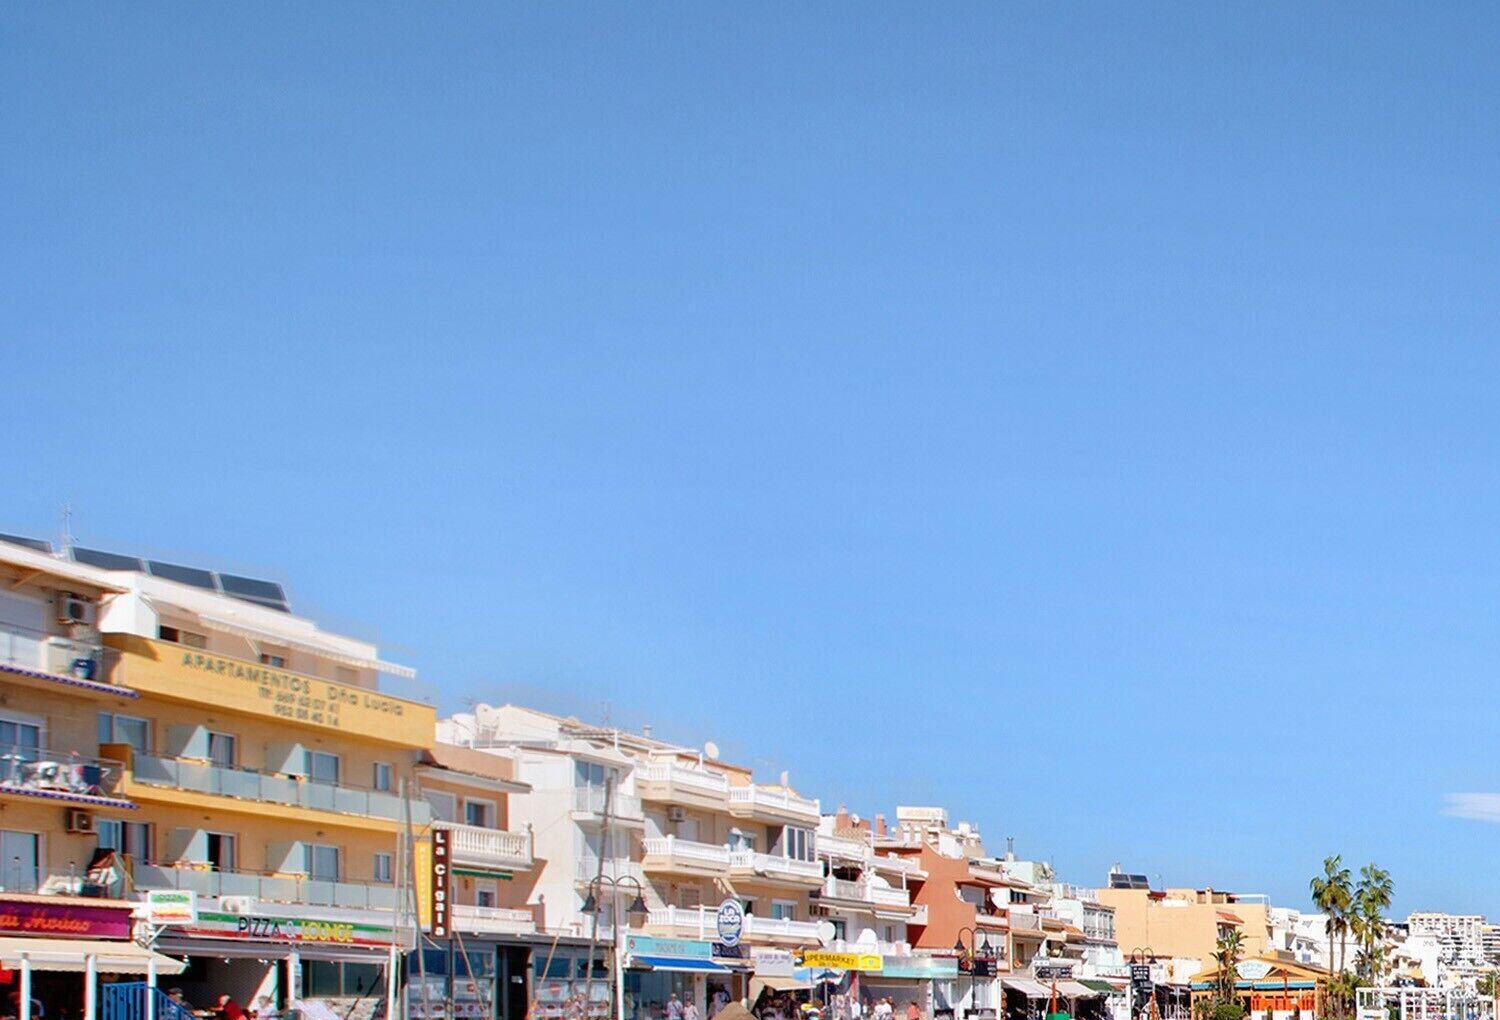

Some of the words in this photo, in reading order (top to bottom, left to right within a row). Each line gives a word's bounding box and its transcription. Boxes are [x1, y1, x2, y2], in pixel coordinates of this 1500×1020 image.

[181, 652, 311, 695] APARTAMENTOS
[434, 831, 447, 856] La
[434, 863, 447, 937] Cigala
[238, 916, 281, 938] PIZZA
[285, 920, 296, 939] &
[301, 921, 354, 943] LOUNGE
